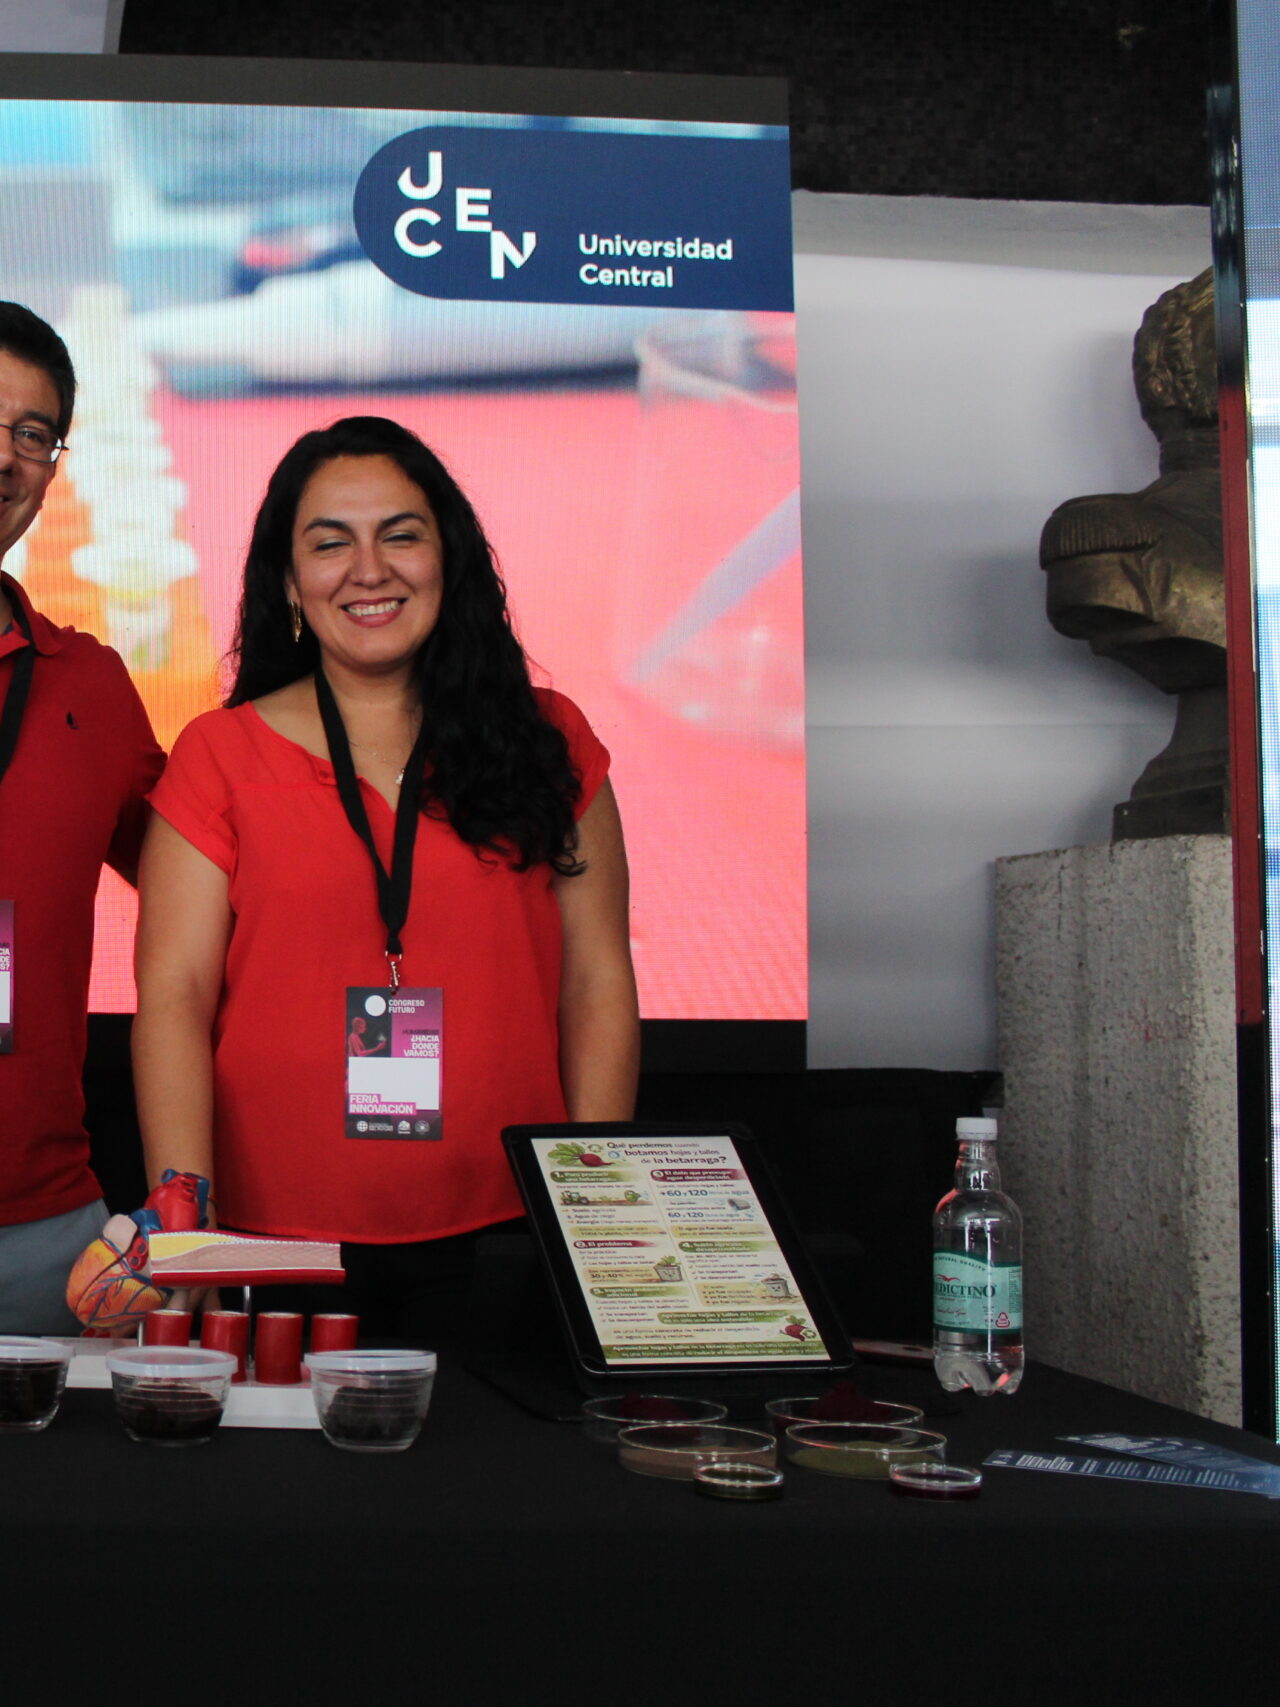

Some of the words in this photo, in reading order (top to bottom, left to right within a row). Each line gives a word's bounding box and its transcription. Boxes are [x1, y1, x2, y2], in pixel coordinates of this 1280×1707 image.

[579, 233, 733, 261] Universidad
[579, 263, 674, 289] Central
[403, 1049, 439, 1058] VAMOS?
[350, 1094, 379, 1104] FERIA
[666, 1156, 727, 1164] betarraga?
